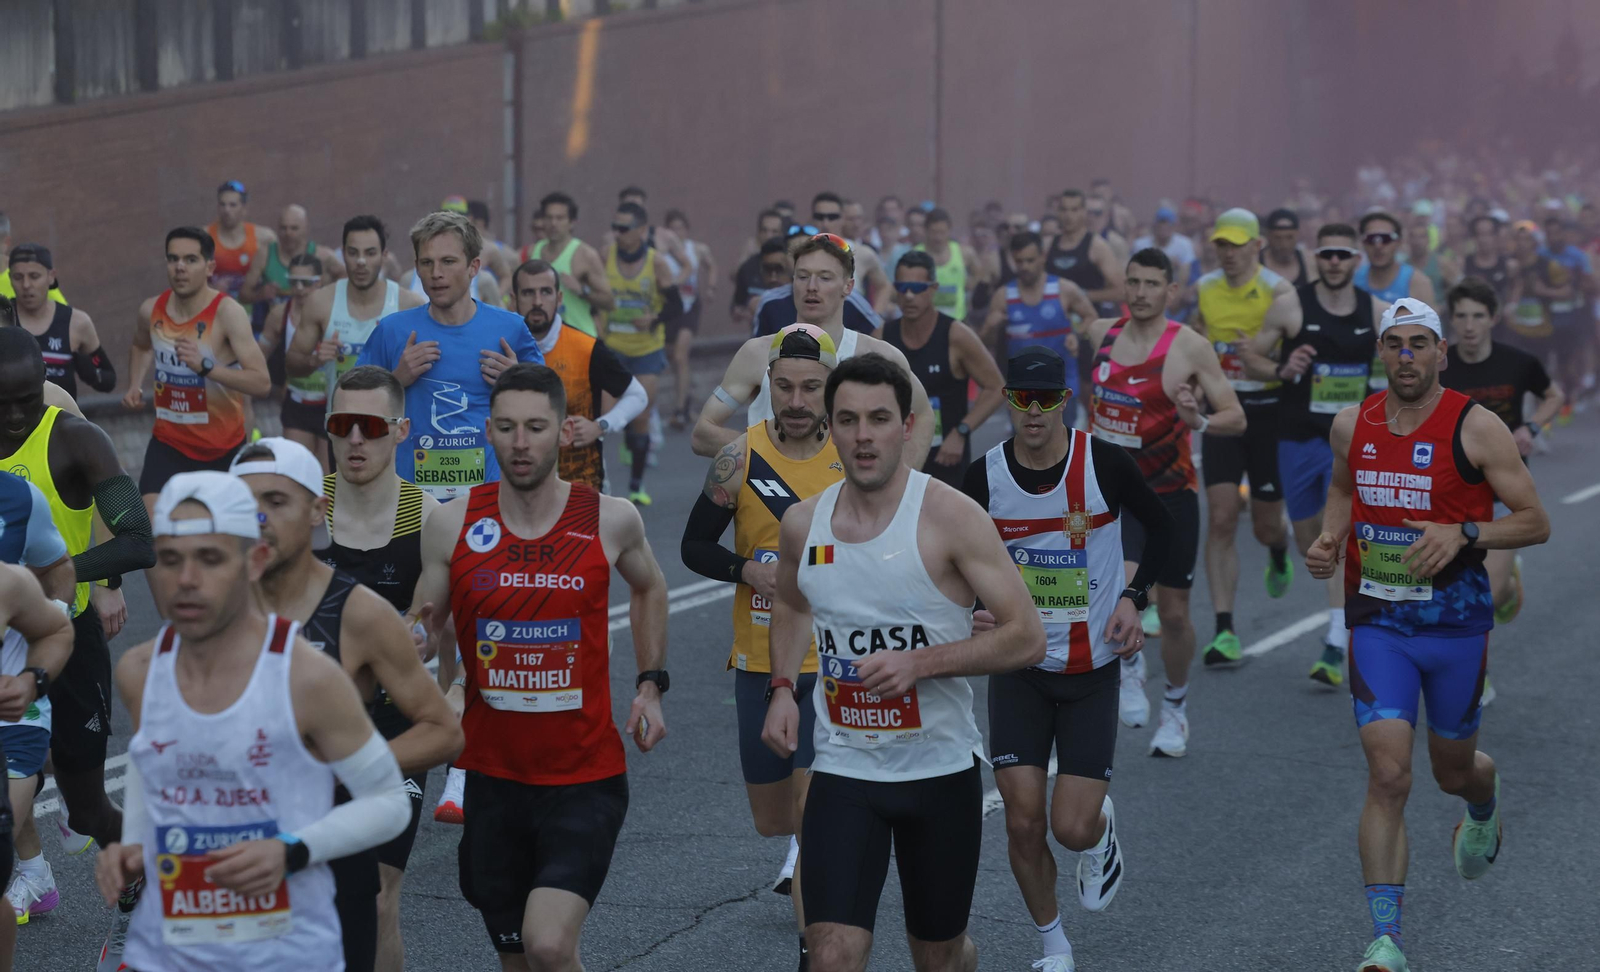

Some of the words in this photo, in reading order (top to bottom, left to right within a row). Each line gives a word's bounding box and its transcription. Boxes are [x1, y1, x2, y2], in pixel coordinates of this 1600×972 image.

[169, 400, 190, 412] JAVI
[437, 436, 476, 447] ZURICH
[439, 456, 460, 466] 2339
[415, 468, 484, 483] SEBASTIAN
[1356, 469, 1378, 485] CLUB
[1378, 471, 1432, 491] ATLETISMO
[1356, 485, 1432, 511] TREBUJENA
[1377, 530, 1421, 543] ZURICH
[506, 544, 555, 562] SER
[1033, 553, 1077, 565] ZURICH
[1379, 552, 1402, 564] 1546
[1035, 575, 1057, 586] 1604
[1361, 565, 1413, 585] ALEJANDRO
[500, 572, 585, 593] DELBECQ
[1048, 595, 1088, 607] RAFAEL
[511, 625, 568, 639] ZURICH
[848, 624, 930, 656] CASA
[513, 652, 544, 665] 1167
[488, 668, 571, 689] MATHIEU
[840, 705, 902, 727] BRIEUC
[193, 829, 265, 850] ZURICH
